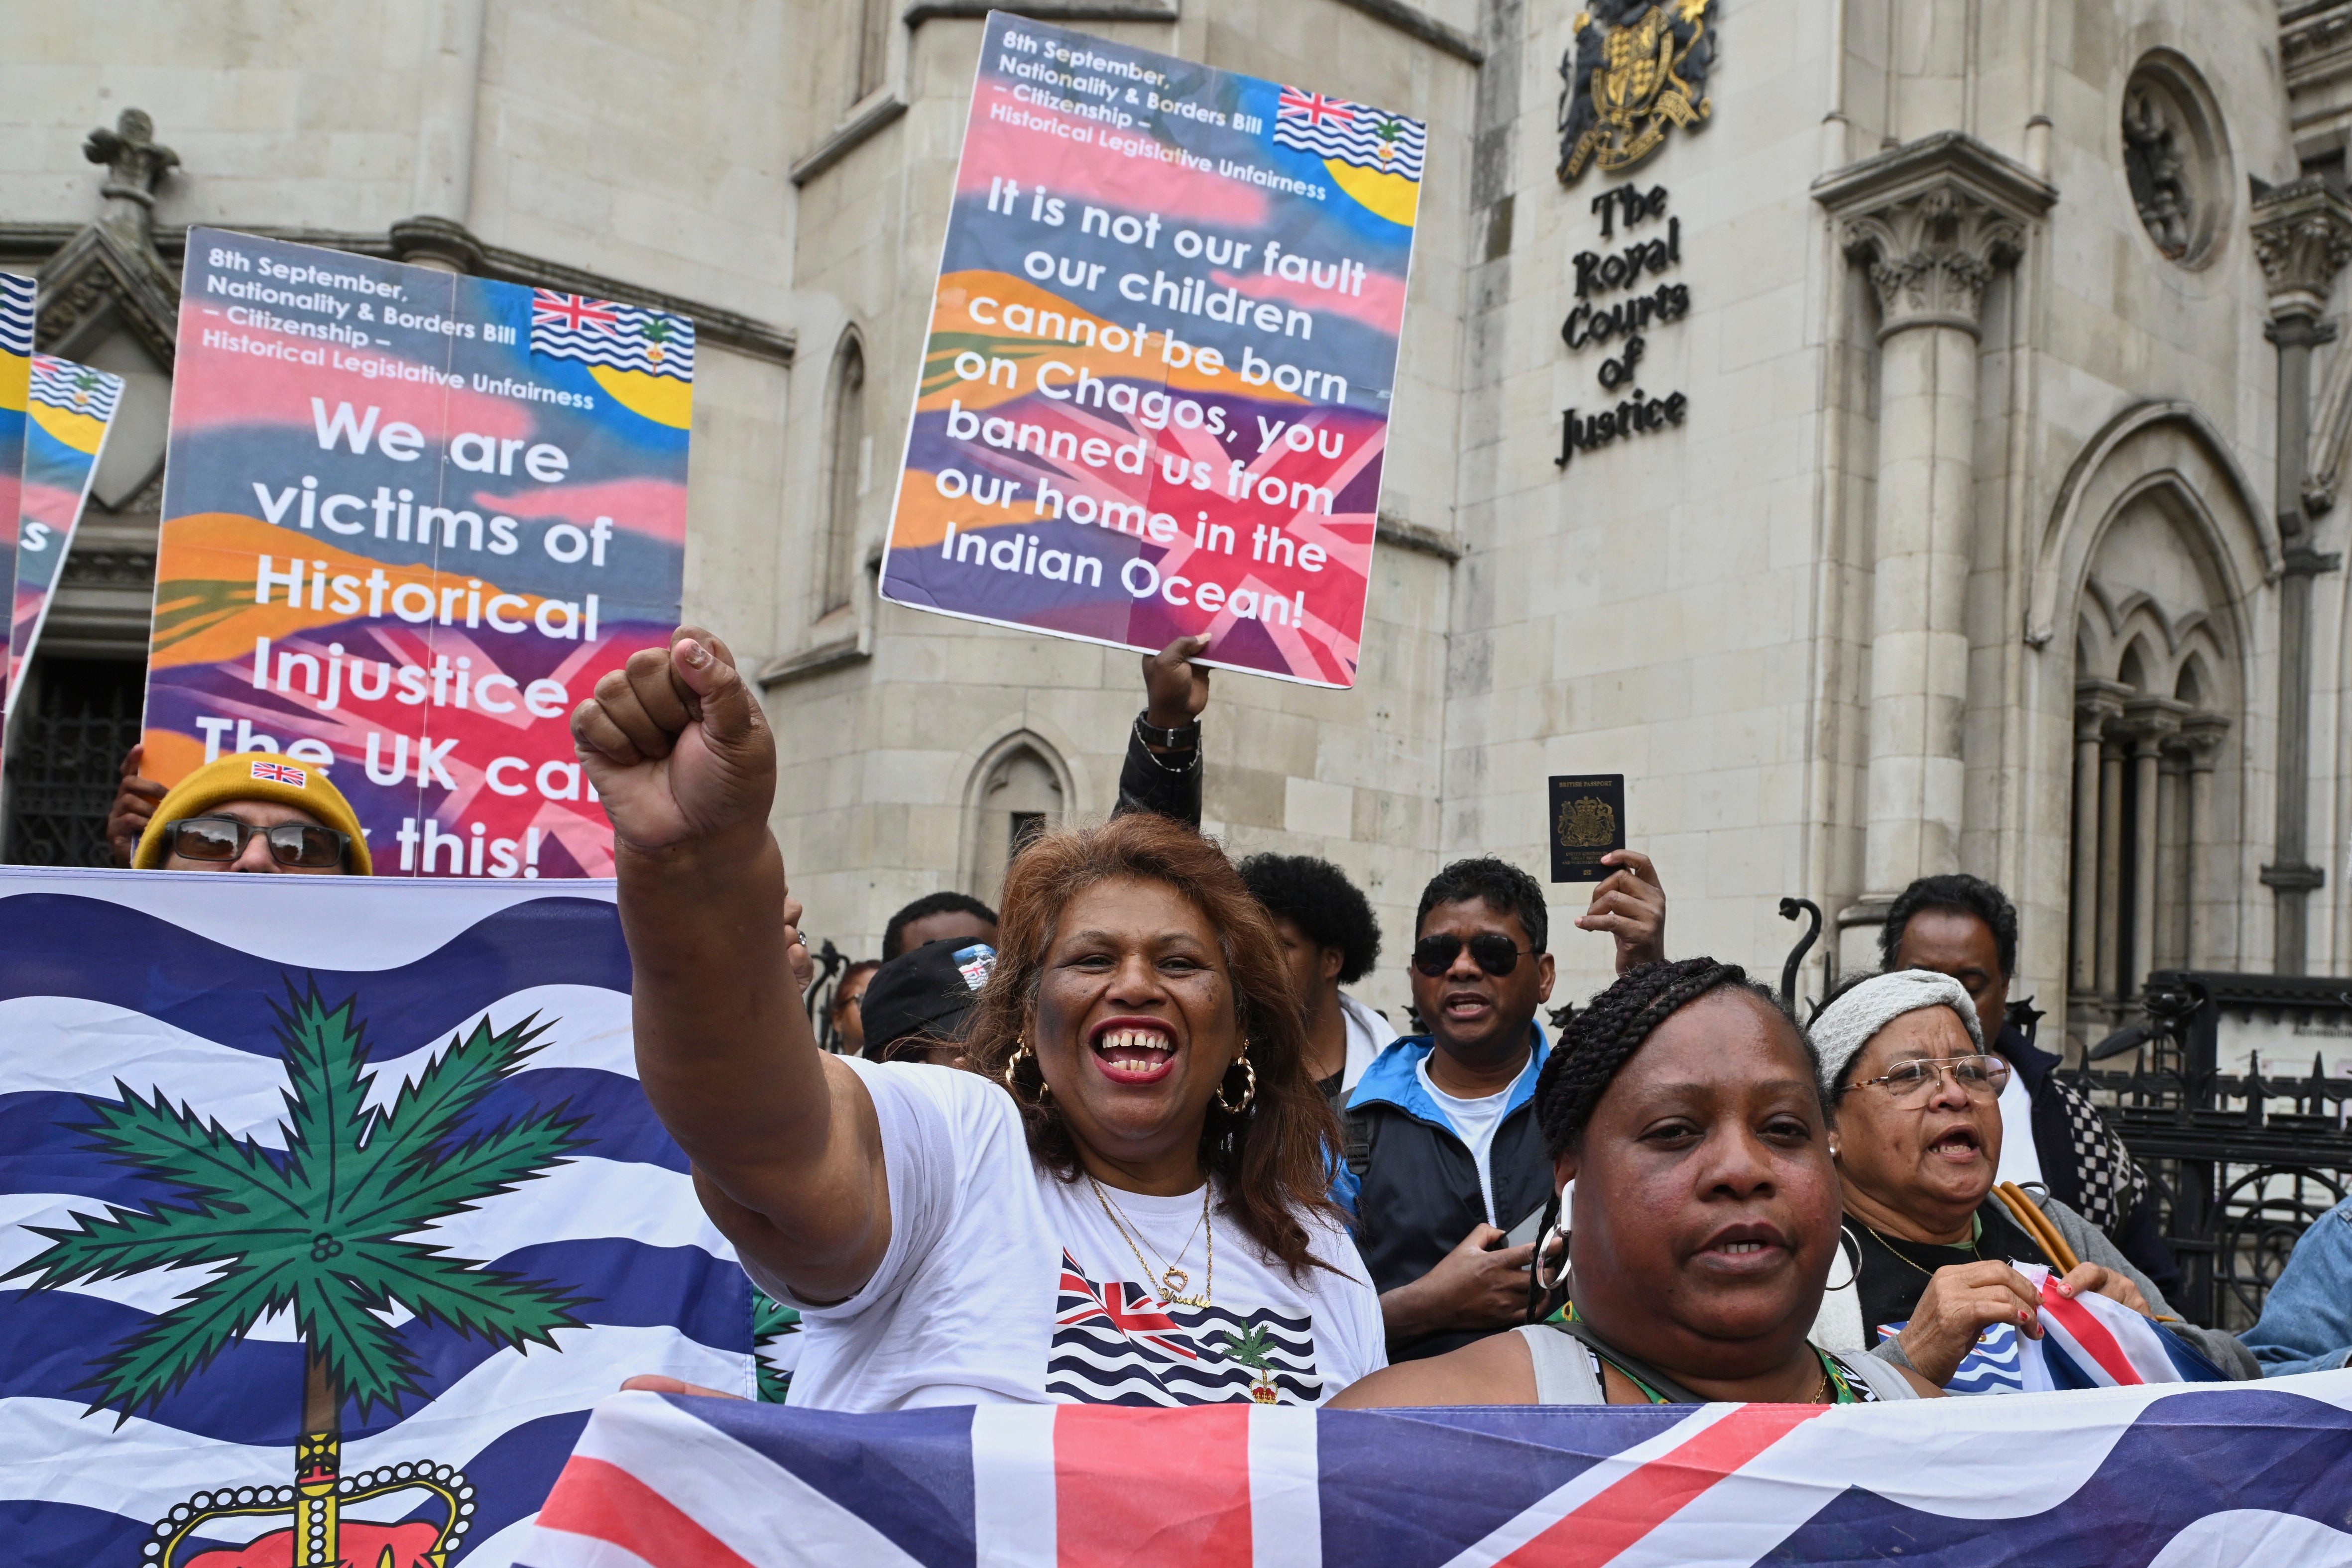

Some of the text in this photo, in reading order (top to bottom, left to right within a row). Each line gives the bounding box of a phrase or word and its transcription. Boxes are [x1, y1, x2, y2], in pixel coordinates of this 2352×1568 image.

[999, 54, 1262, 135] Nationality & Borders Bill
[1003, 31, 1171, 90] 8th September,
[1014, 84, 1132, 130] Citizenship
[991, 103, 1326, 201] Historical Legislative Unfairness
[988, 176, 1367, 297] It is not our fault
[1591, 183, 1667, 236] The
[209, 248, 409, 302] 8th September,
[1025, 251, 1312, 339] our children
[1573, 217, 1680, 299] Royal
[207, 275, 516, 345] Nationality & Borders Bill
[227, 306, 368, 348] Citizenship
[969, 297, 1347, 404] cannot be born
[1562, 283, 1689, 351] Courts
[204, 329, 594, 410] Historical Legislative Unfairness
[1599, 335, 1644, 390] of
[311, 397, 568, 481] We are
[954, 351, 1343, 458] on Chagos, you
[1554, 388, 1687, 470] Justice
[946, 399, 1333, 516] banned us from
[253, 476, 613, 565] victims of
[936, 468, 1326, 571] our home in the
[256, 555, 597, 641] Historical
[942, 522, 1304, 628] Indian Ocean!
[253, 637, 568, 717] Injustice
[197, 717, 598, 801] The UK ca
[397, 817, 539, 879] this!
